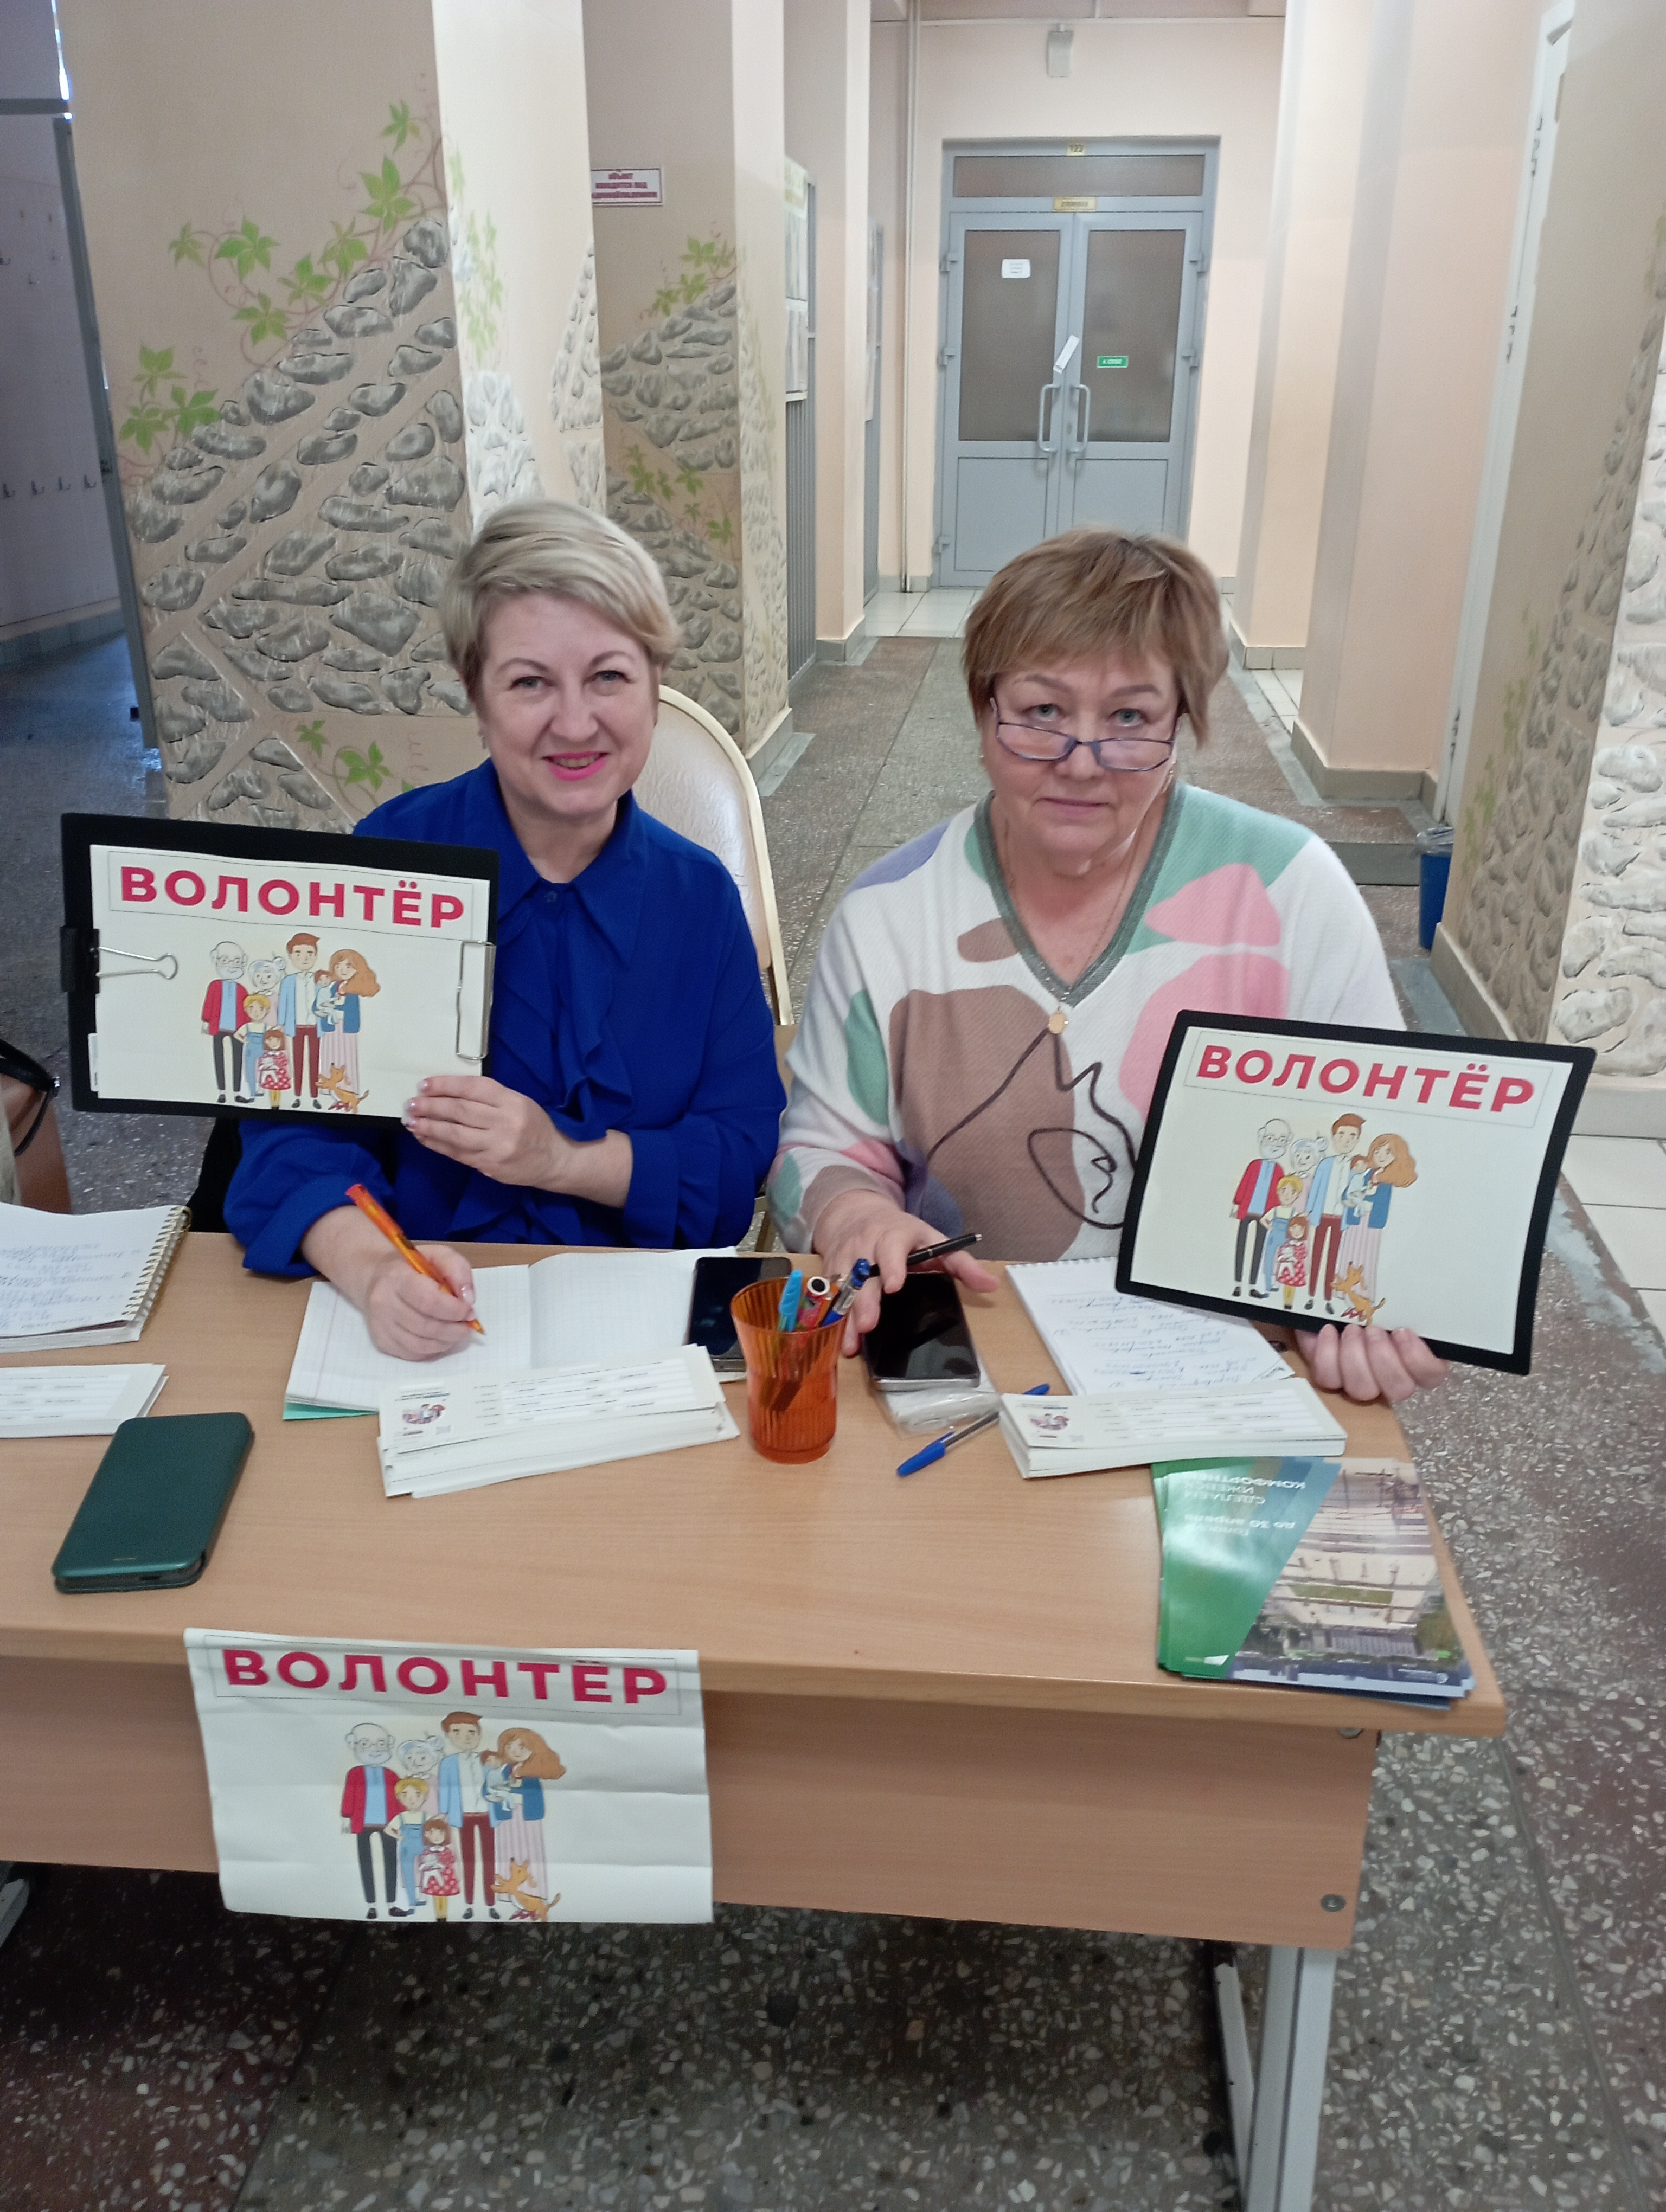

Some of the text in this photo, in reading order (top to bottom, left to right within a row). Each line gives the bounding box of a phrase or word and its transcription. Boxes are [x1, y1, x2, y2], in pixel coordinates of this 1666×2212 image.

[120, 866, 464, 928] ВОЛОНТЁР
[1196, 1045, 1534, 1112] ВОЛОНТЁР
[222, 1649, 667, 1703] ВОЛОНТЁР
